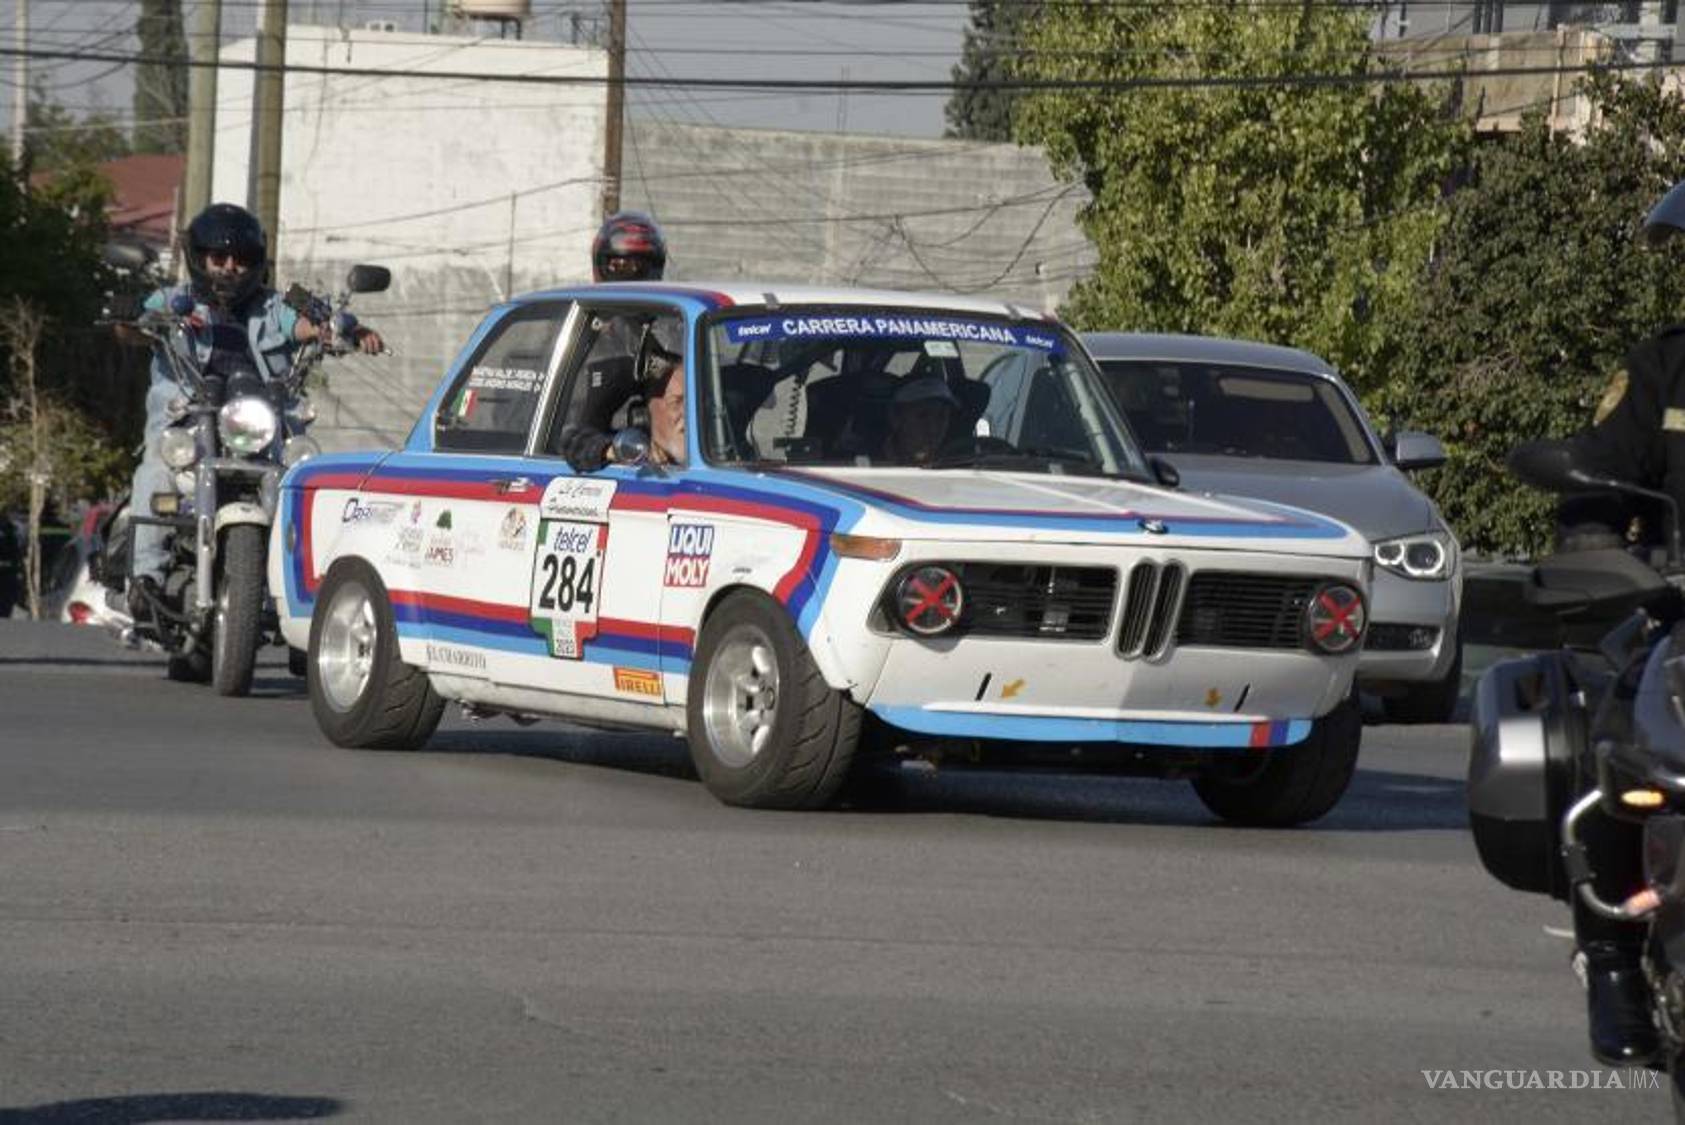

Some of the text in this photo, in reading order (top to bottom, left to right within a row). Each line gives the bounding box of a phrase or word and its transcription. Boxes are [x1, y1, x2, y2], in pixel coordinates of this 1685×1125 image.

[782, 318, 1017, 344] CARRERA PANAMERICANA
[553, 526, 593, 553] telcel
[669, 526, 713, 556] LIQUI
[538, 553, 596, 614] 284
[665, 558, 710, 585] MOLY
[613, 667, 662, 696] PIRELLI
